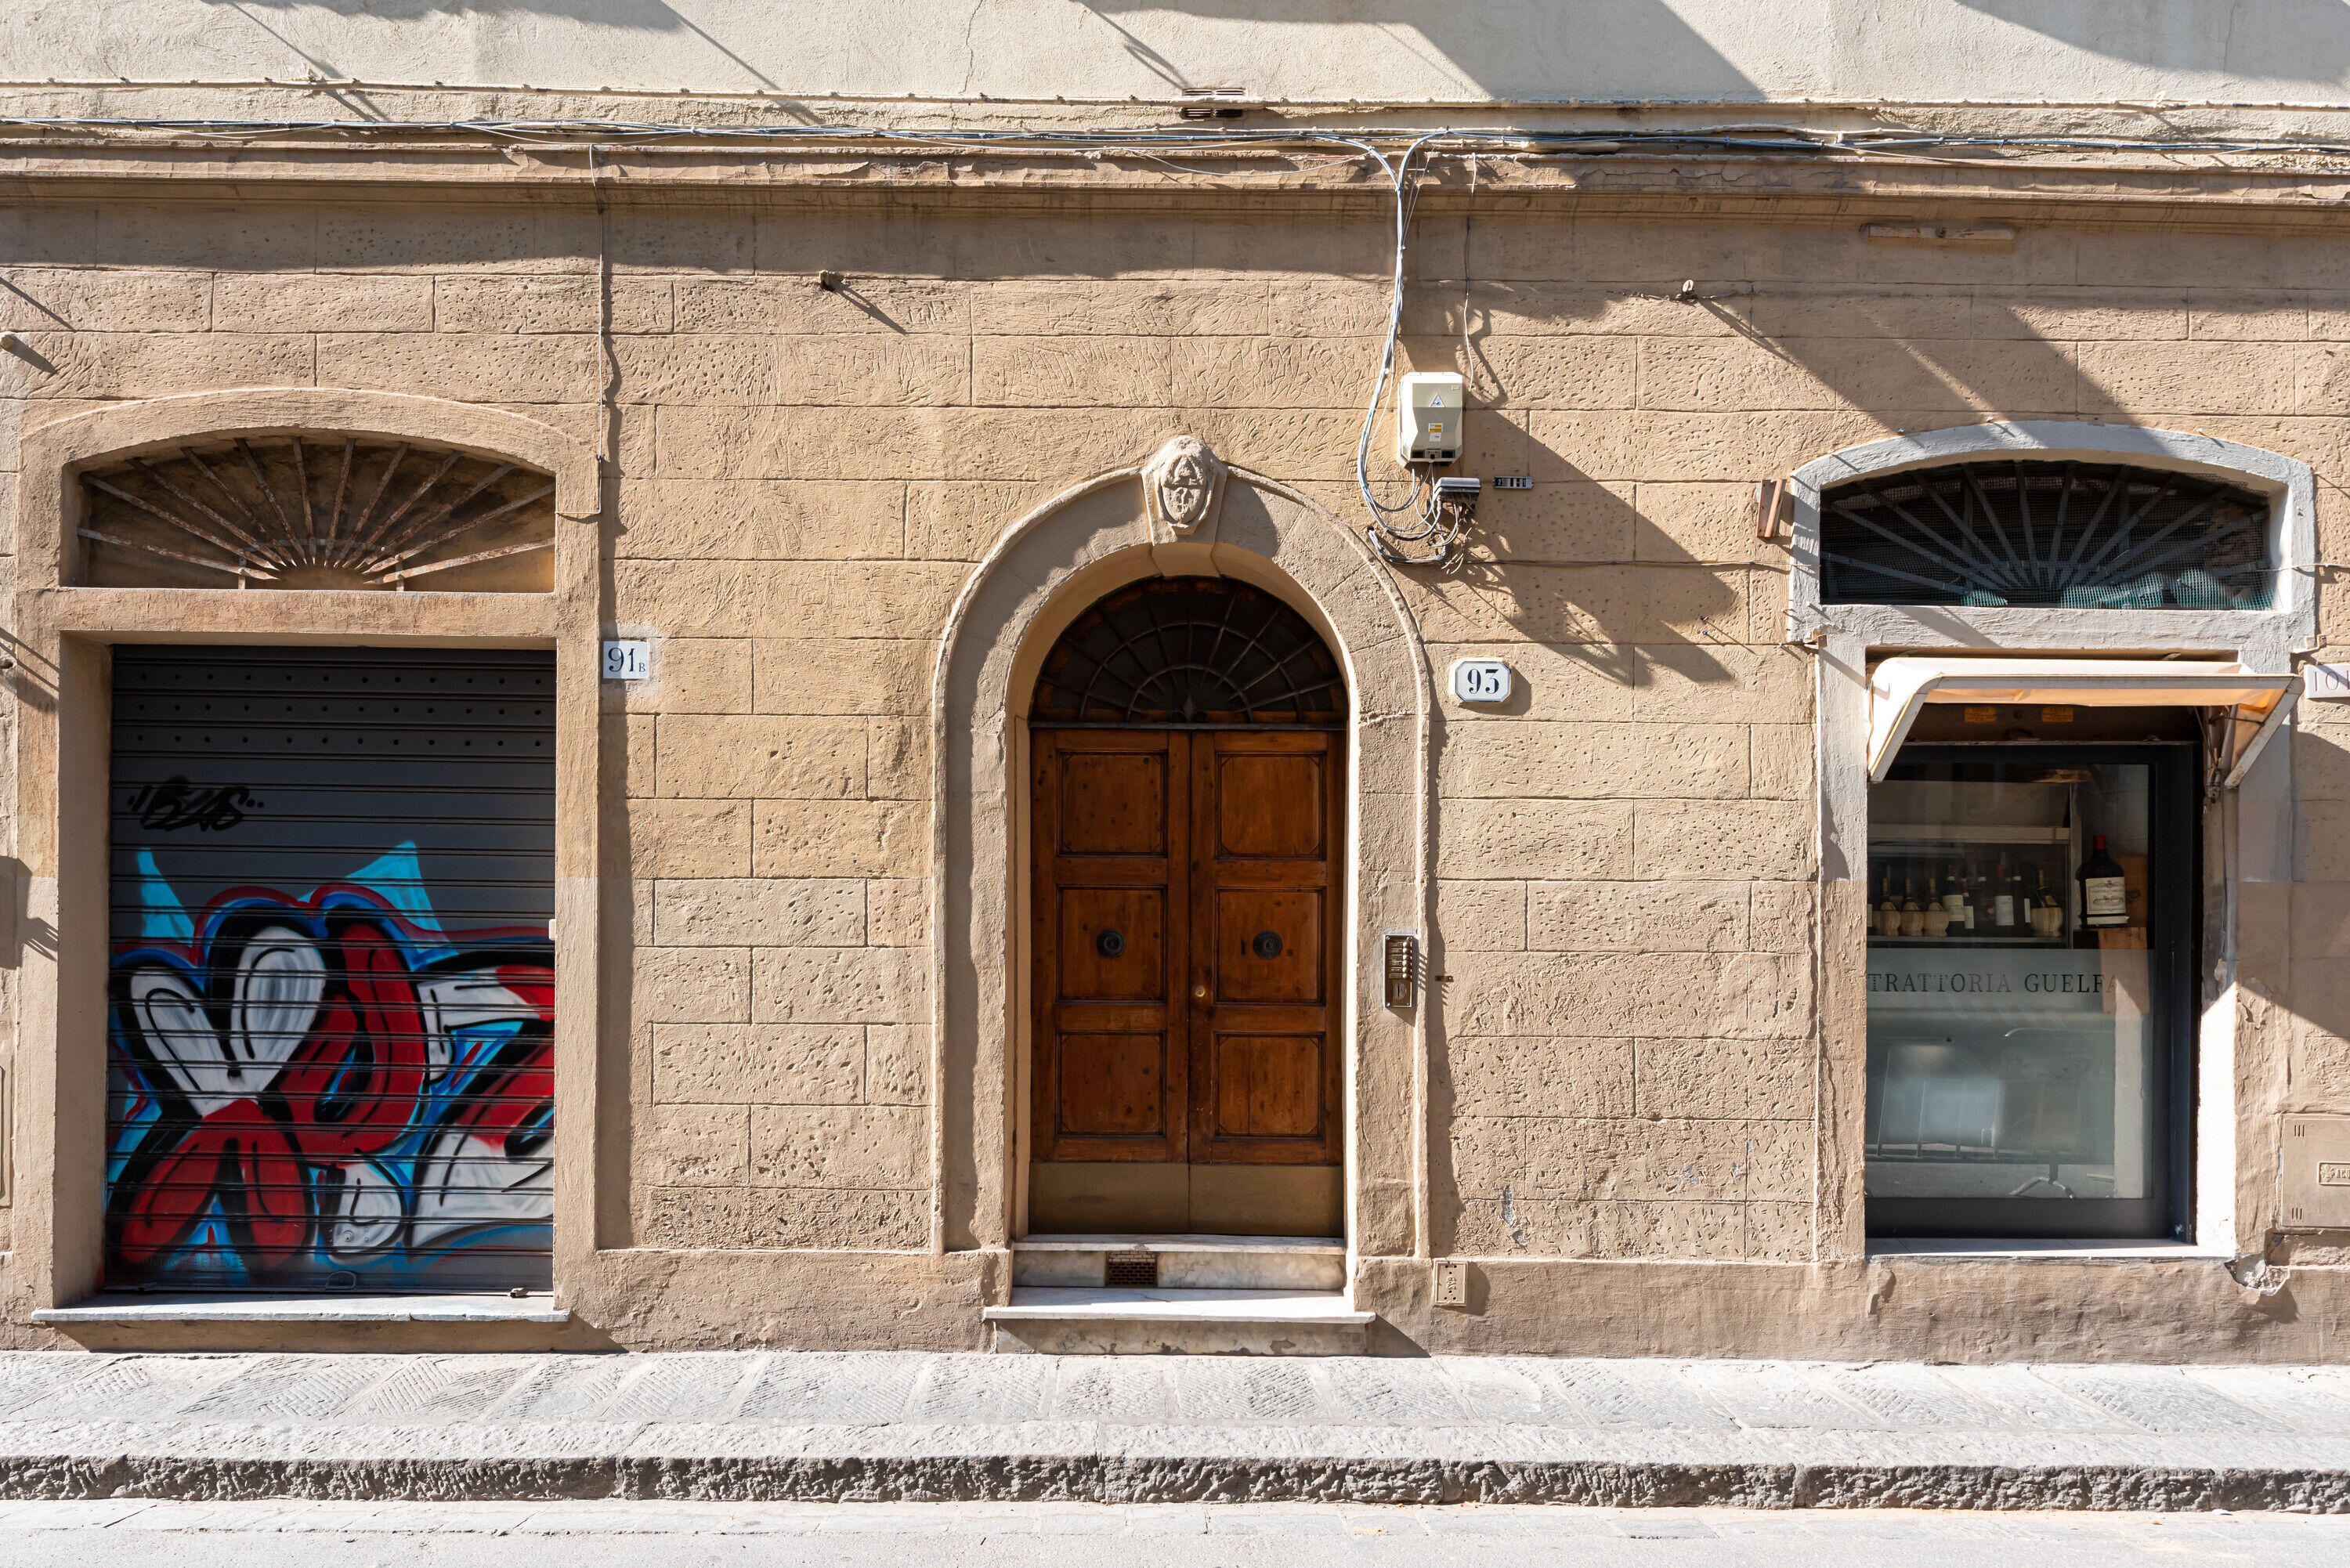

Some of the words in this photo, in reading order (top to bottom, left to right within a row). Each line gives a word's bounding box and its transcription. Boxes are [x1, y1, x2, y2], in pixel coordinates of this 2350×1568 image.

[1467, 668, 1500, 695] 93
[1867, 973, 2012, 993] TRATTORIA
[2023, 973, 2117, 993] GUELFA
